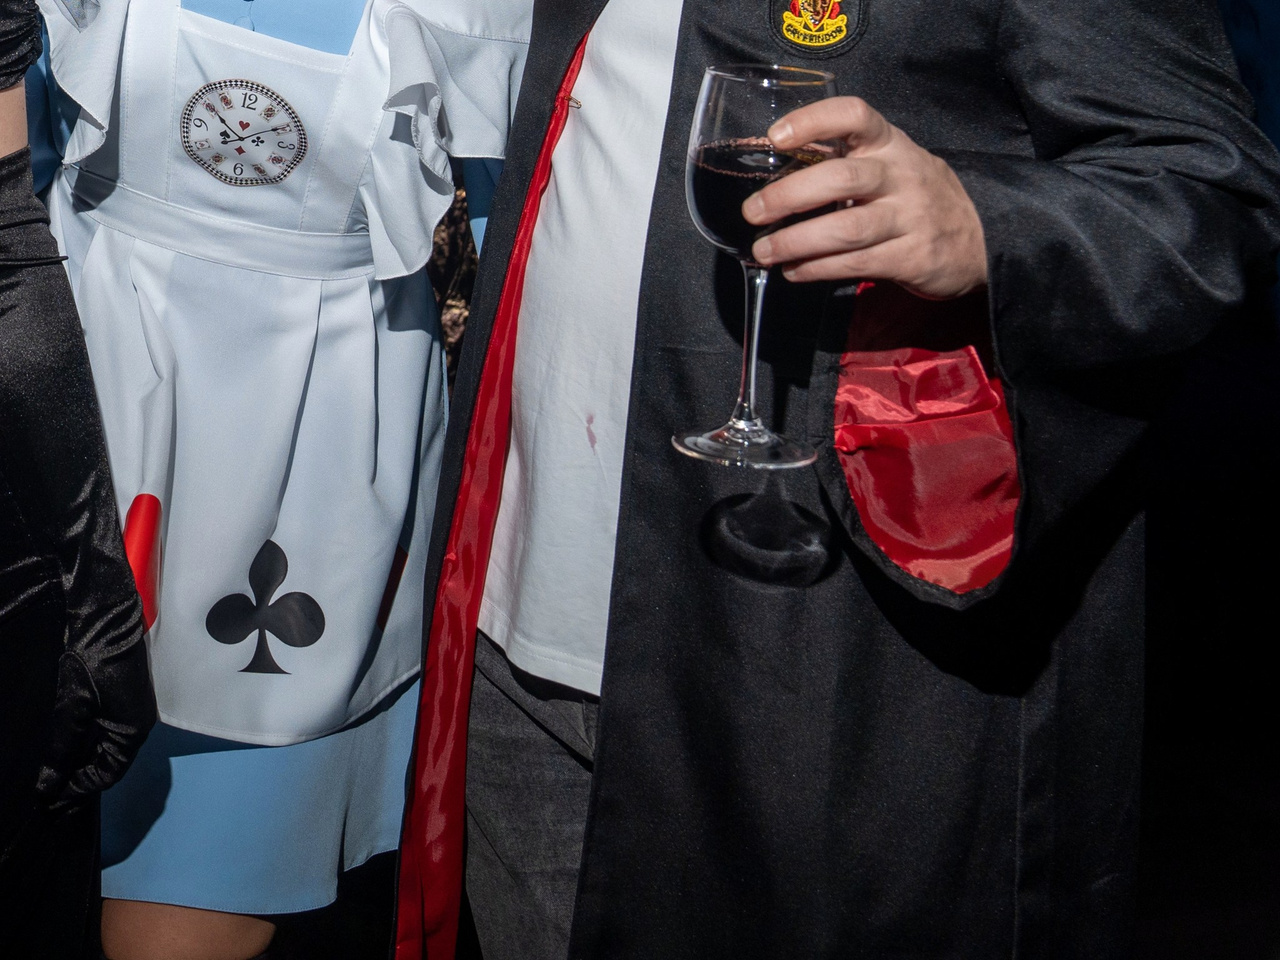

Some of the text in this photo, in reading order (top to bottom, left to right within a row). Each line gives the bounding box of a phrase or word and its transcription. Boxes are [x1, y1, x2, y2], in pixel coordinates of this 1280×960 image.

[241, 92, 258, 111] 12
[193, 117, 209, 131] 9
[277, 141, 296, 151] 3
[233, 162, 244, 176] 6
